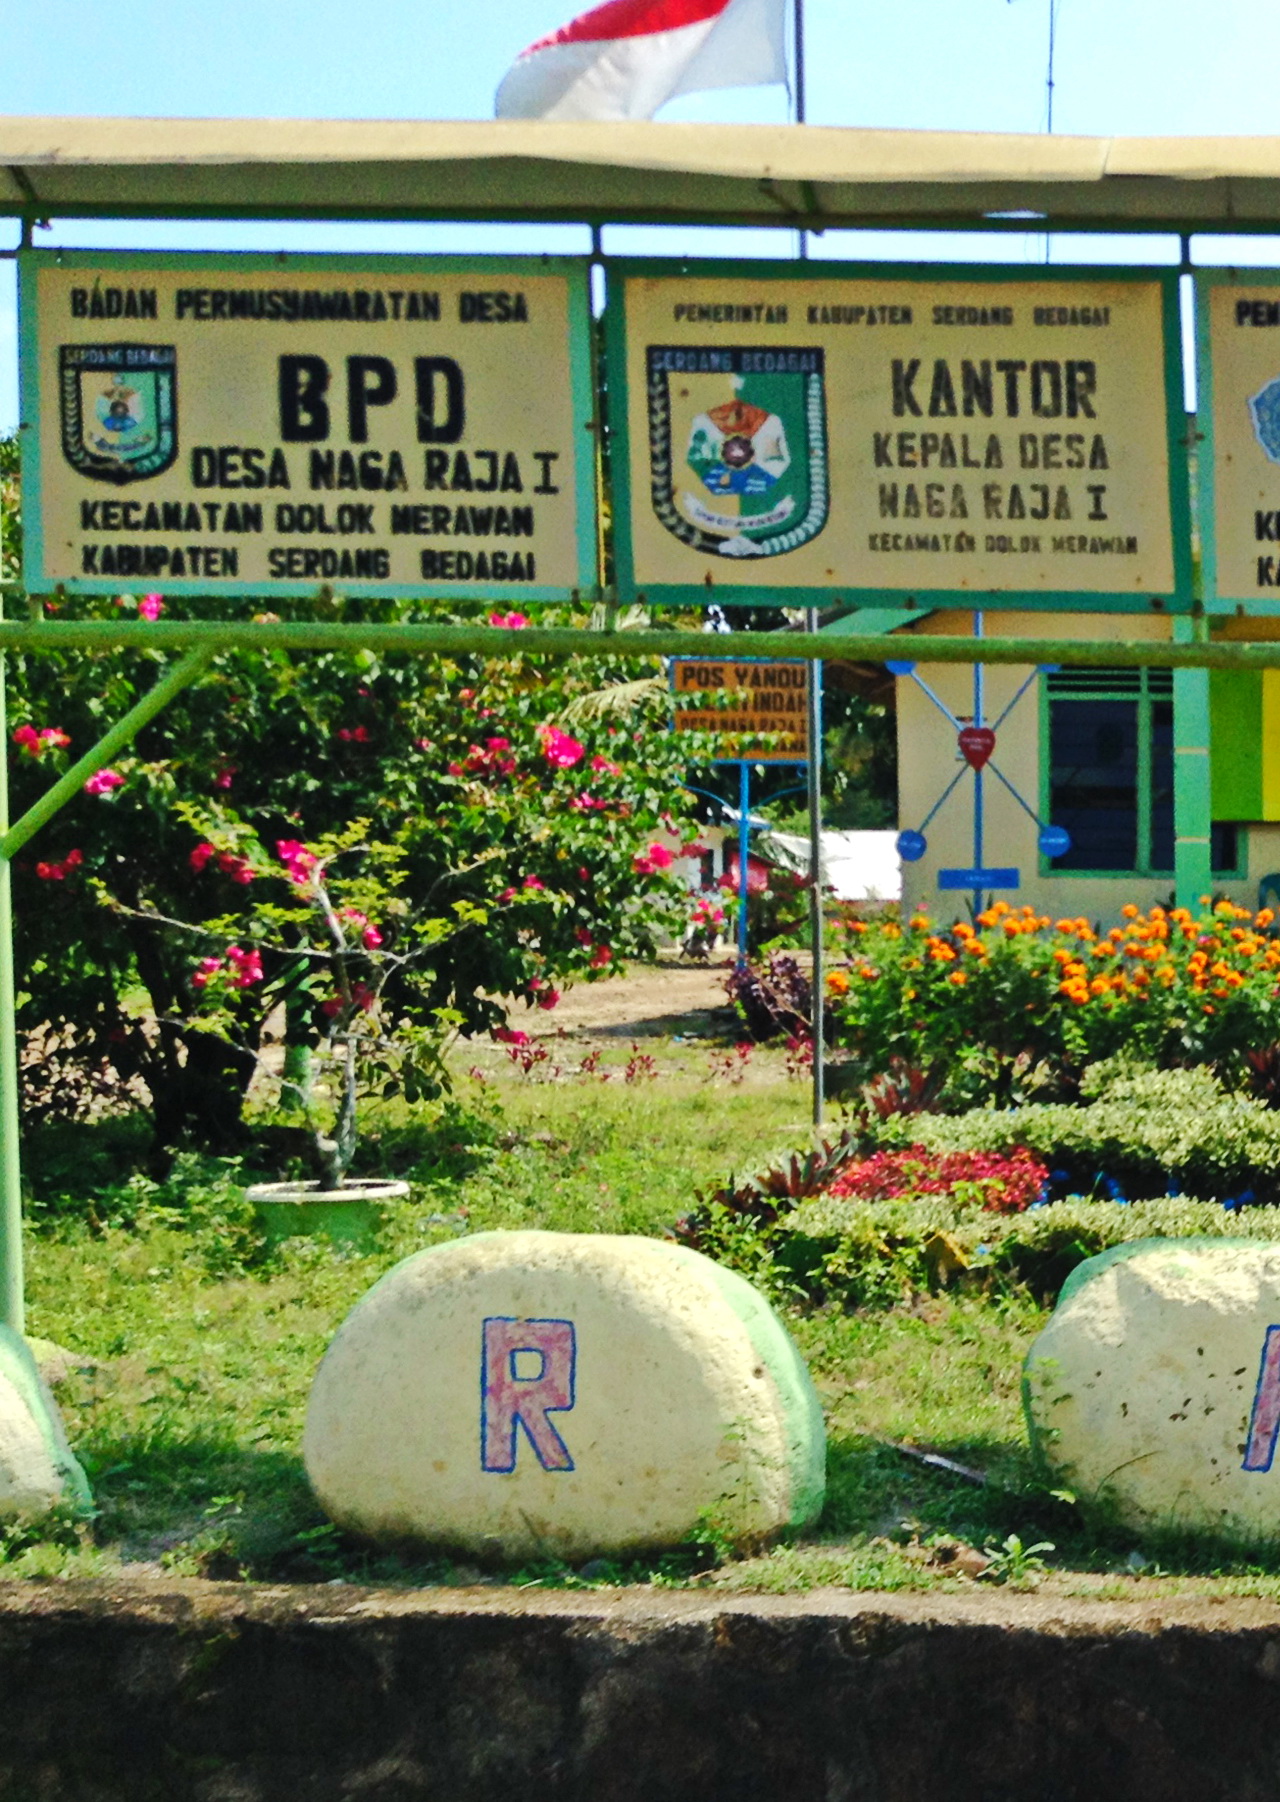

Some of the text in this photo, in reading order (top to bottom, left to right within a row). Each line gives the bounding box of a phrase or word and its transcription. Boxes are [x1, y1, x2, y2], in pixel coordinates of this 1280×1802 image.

[71, 287, 158, 319] BADAN
[459, 291, 528, 322] DESA
[674, 303, 1110, 327] PEMERINTAH KABUPATEN SERDANG BEDAGAI
[652, 351, 817, 373] SERDANG BEDAGAI
[278, 353, 466, 445] BPD
[891, 359, 1097, 418] KANTOR
[874, 432, 1109, 471] KEPALA DESA
[191, 447, 559, 494] DESA NAGA RAJA I
[80, 500, 534, 537] KECAMATAN DOLOK MERAWAN
[879, 483, 1109, 521] NAGA RAJA I
[869, 532, 1138, 555] KECAMATAN DOLOK MERAWAN
[82, 545, 536, 581] KABUPATEN SERDANG BEDAGAI
[682, 666, 725, 688] POS
[480, 1316, 577, 1473] R
